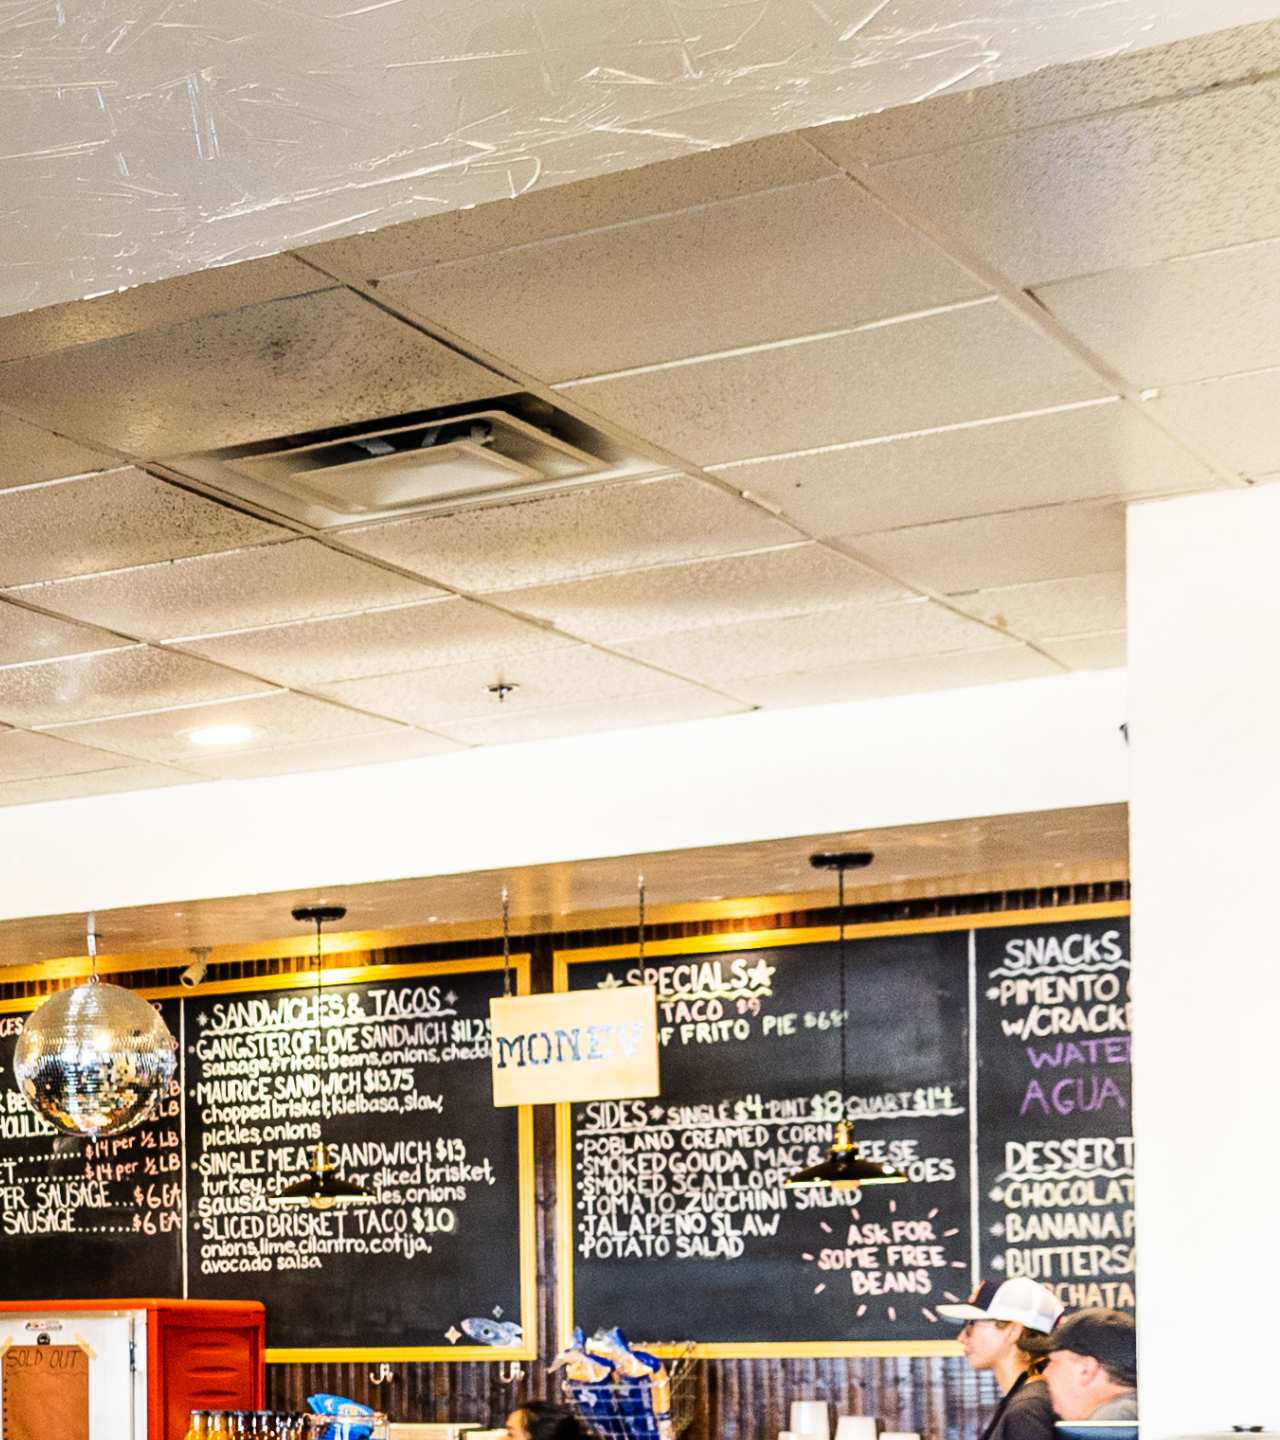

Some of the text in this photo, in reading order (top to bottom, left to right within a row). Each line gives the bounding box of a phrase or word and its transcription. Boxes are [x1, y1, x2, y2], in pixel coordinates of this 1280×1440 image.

[1003, 930, 1123, 968] SNACKS
[627, 959, 749, 996] SPECIALS
[999, 973, 1121, 1007] PIMENTO
[211, 986, 440, 1030] SANDWICHES & TACOS
[660, 1000, 724, 1024] TACO
[196, 1031, 290, 1061] GANGSTER
[360, 1021, 448, 1050] SANDWICH
[680, 1018, 751, 1046] FRITO
[762, 1012, 798, 1037] PIE
[441, 1043, 492, 1062] chedd
[496, 1024, 644, 1068] MONEY
[196, 1076, 272, 1105] MAURICE
[274, 1071, 361, 1101] SANDWICH
[1018, 1073, 1127, 1117] AGUA
[201, 1100, 271, 1125] chopped
[585, 1086, 955, 1130] SIDES SINGLE $4 PINT $8 QUART $14
[84, 1141, 109, 1159] $14
[111, 1135, 137, 1156] per
[159, 1131, 180, 1148] LB
[583, 1122, 833, 1157] POBLANO CREAMED CORN
[84, 1162, 113, 1181] $14
[116, 1161, 139, 1182] per
[159, 1152, 181, 1173] LB
[199, 1150, 265, 1176] SINGLE
[327, 1140, 432, 1168] SANDWICH
[435, 1137, 466, 1162] $13
[583, 1152, 668, 1176] SMOKED
[668, 1149, 748, 1174] GOUDA
[753, 1145, 805, 1169] MAC
[806, 1145, 826, 1167] &
[347, 1171, 370, 1187] or
[372, 1163, 421, 1187] sliced
[425, 1157, 496, 1185] brisket,
[583, 1174, 668, 1197] SMOKED
[35, 1180, 113, 1209] SAUSAGE
[162, 1182, 181, 1211] EA
[583, 1187, 863, 1217] TOMATO ZUCCHINI SALAD
[2, 1207, 77, 1236] SAUSAGE
[159, 1211, 182, 1233] EA
[202, 1206, 455, 1241] SLICED BRISKET TACO $10
[583, 1211, 781, 1238] JALAPENO SLAW
[847, 1220, 937, 1246] ASK FOR
[1004, 1211, 1123, 1244] BANANA
[583, 1232, 745, 1259] POTATO SALAD
[817, 1245, 947, 1271] SOME FREE
[201, 1254, 322, 1275] avocado salsa
[850, 1268, 932, 1296] BEANS
[5, 1348, 81, 1369] SOLD OUT
